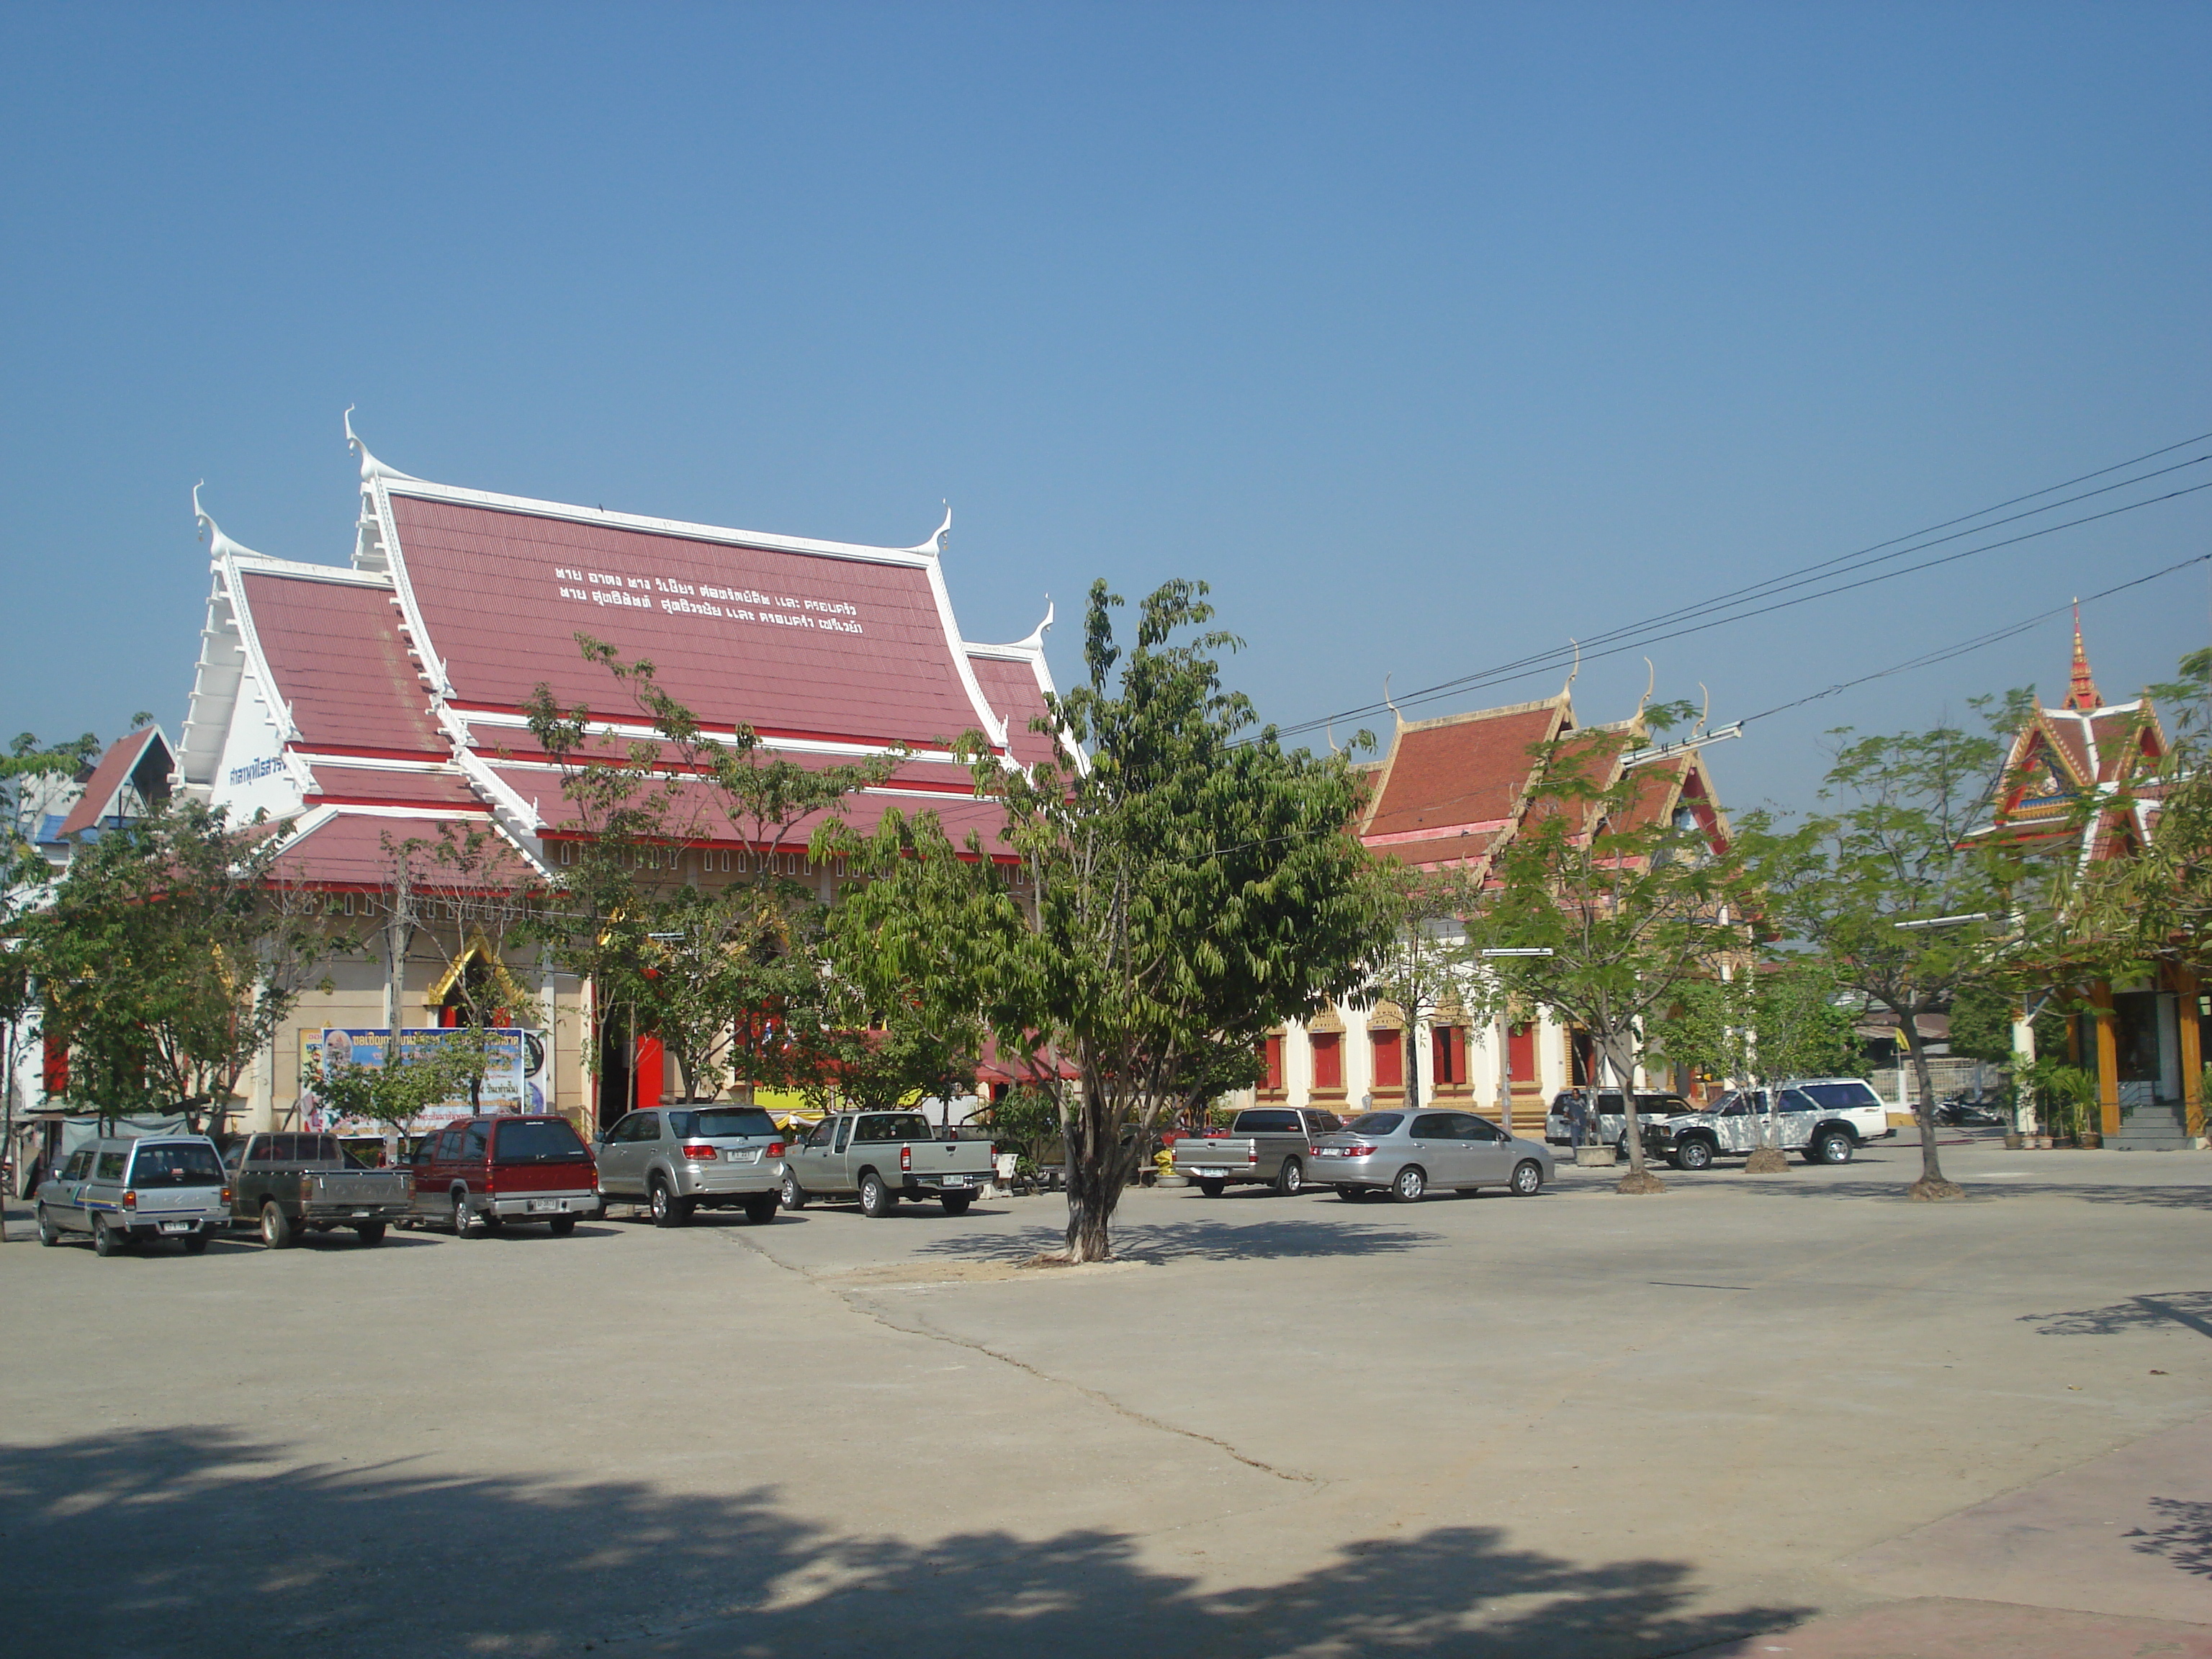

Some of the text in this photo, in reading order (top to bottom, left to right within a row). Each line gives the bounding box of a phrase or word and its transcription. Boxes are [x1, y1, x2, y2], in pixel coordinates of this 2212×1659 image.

[556, 568, 583, 581] นาย
[627, 577, 651, 590] นาง
[655, 577, 695, 595] วิเชียร
[775, 595, 800, 608] และ
[804, 601, 856, 616] ครอบครัว
[559, 587, 587, 600] นาย
[726, 607, 755, 621] และ
[760, 613, 814, 627] ครอบครัว
